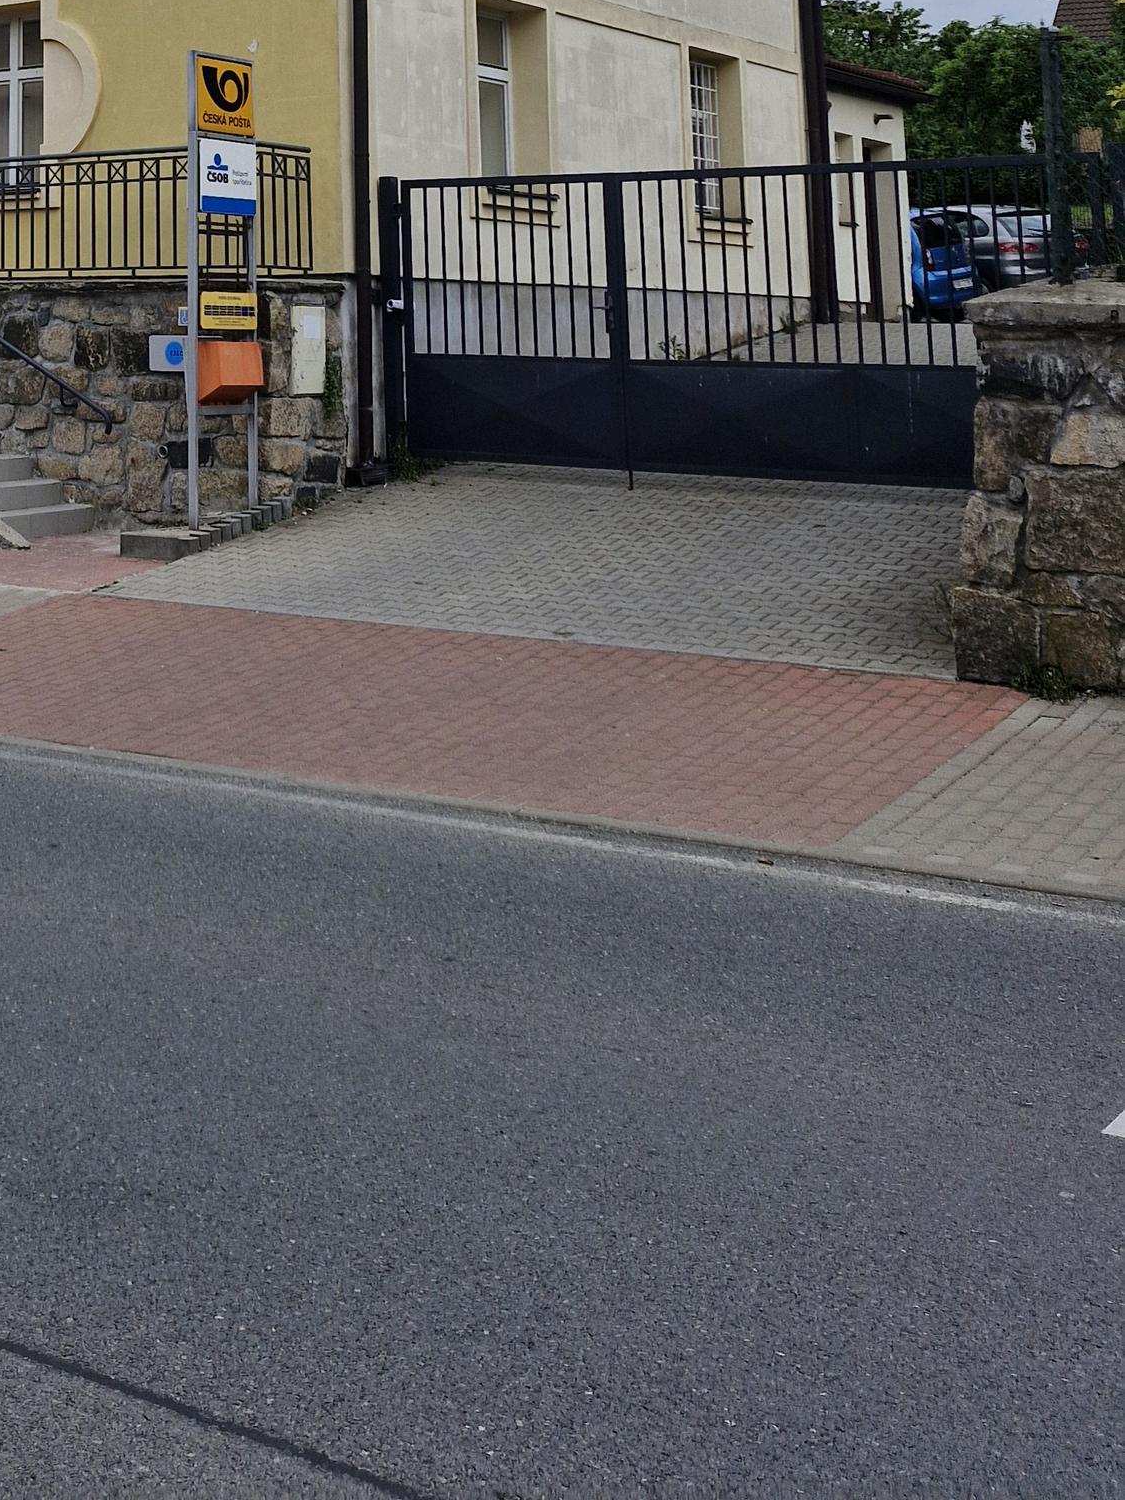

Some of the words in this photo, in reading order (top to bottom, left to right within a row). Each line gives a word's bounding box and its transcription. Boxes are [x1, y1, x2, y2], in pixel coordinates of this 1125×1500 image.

[203, 111, 227, 125] ČESKÁ
[229, 116, 251, 129] POŠTA
[207, 170, 229, 184] ČSOB
